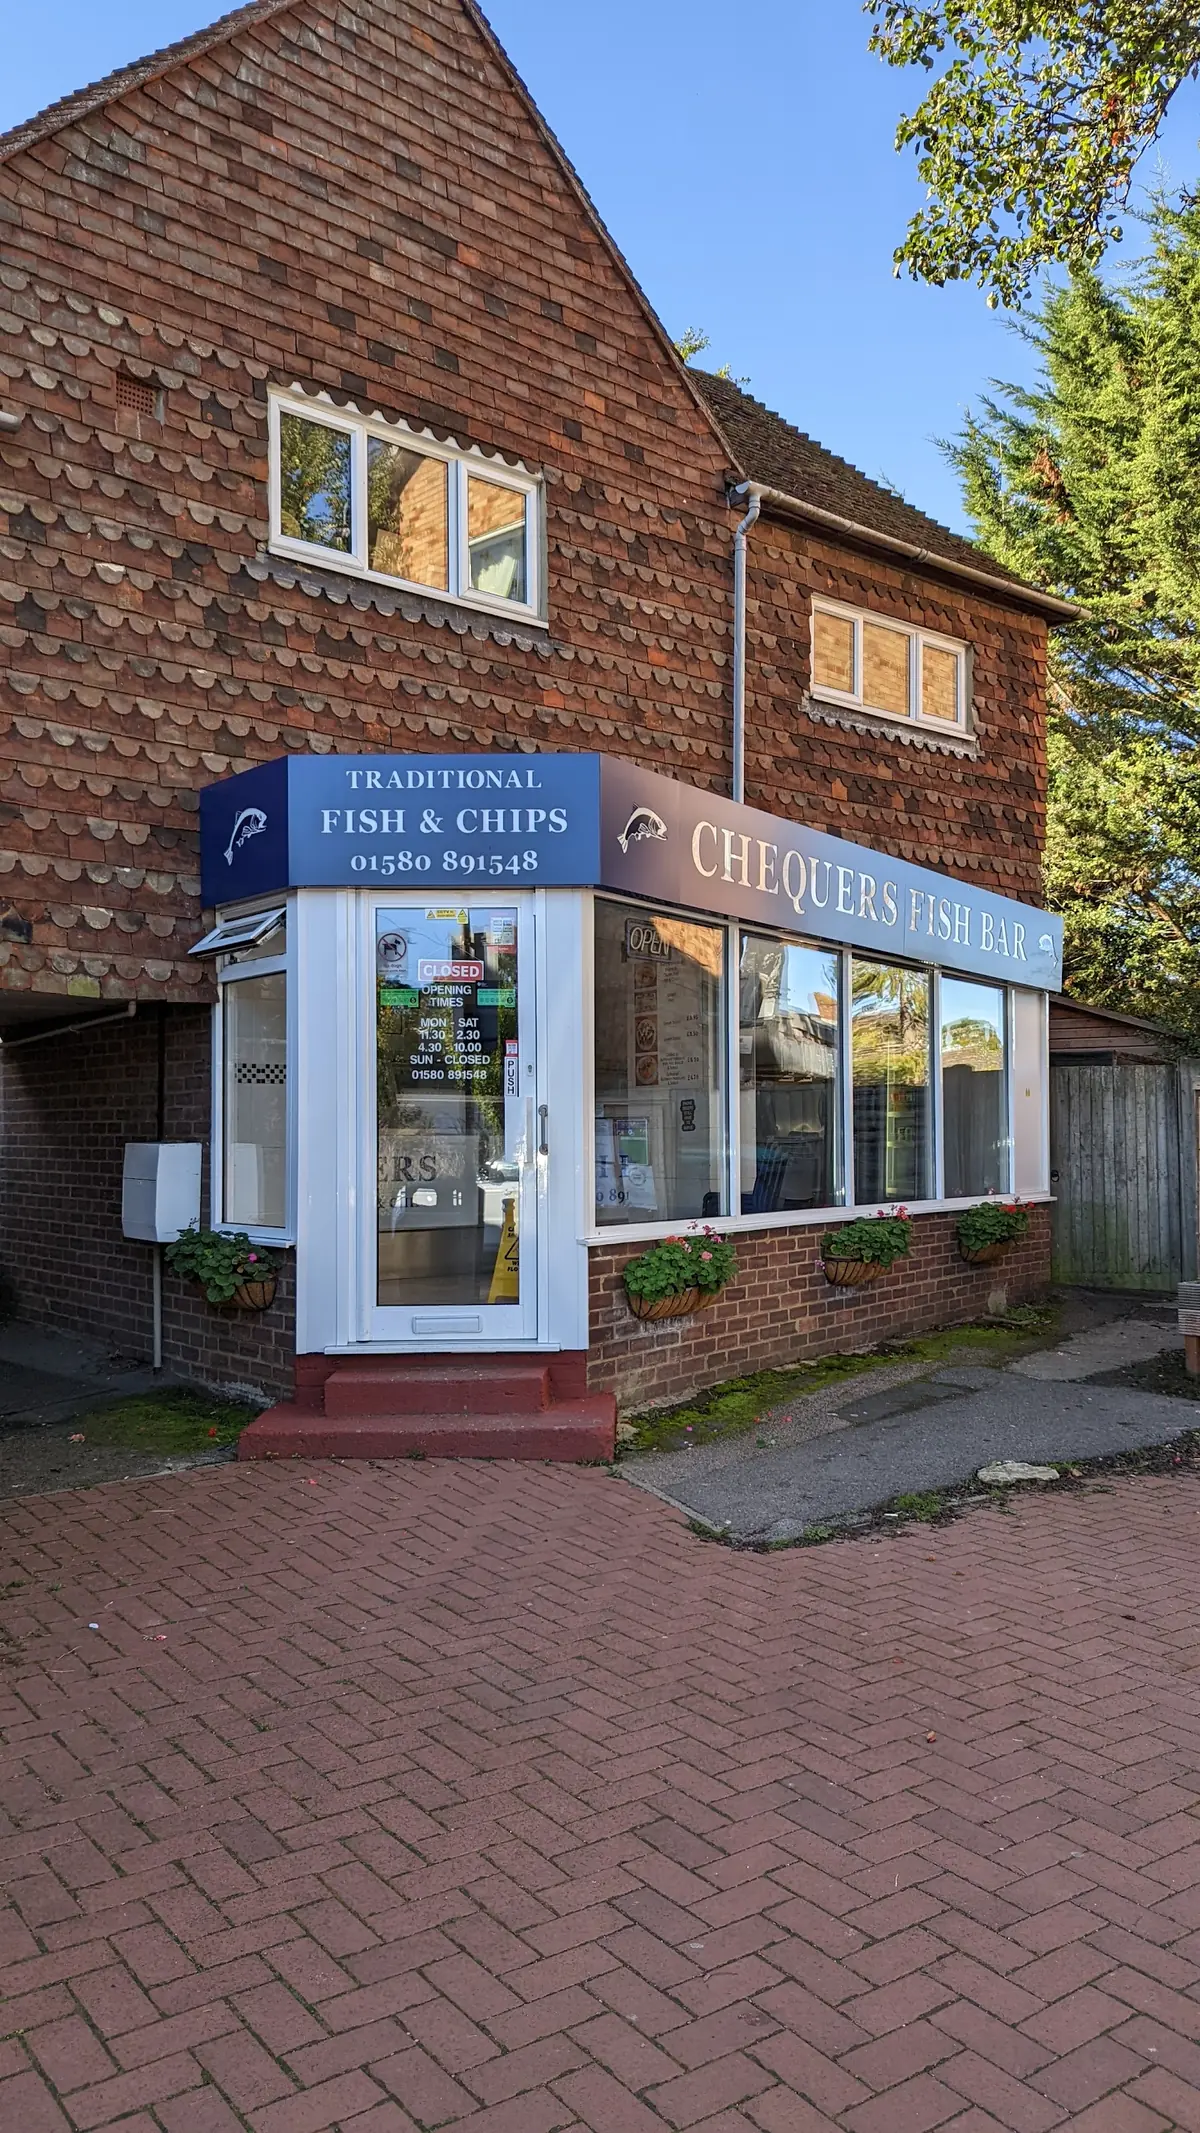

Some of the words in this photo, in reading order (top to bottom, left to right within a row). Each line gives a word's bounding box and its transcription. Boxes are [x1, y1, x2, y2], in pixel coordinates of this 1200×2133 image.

[346, 769, 542, 789] TRADITIONAL
[321, 809, 406, 834] FISH
[420, 809, 445, 834] &
[456, 808, 568, 834] CHIPS
[350, 850, 431, 877] 01580
[442, 850, 539, 877] 891548
[691, 820, 899, 927] CHEQUERS
[908, 888, 972, 947] FISH
[979, 911, 1028, 962] BAR
[630, 926, 670, 956] OPEN
[423, 965, 480, 978] CLOSED
[422, 985, 472, 995] OPENING
[430, 998, 464, 1007] TIMES
[420, 1018, 447, 1027] MON
[458, 1018, 479, 1027] SAT
[421, 1030, 446, 1040] 11.30
[456, 1030, 480, 1040] 2.30
[418, 1043, 442, 1052] 4.30
[454, 1043, 482, 1052] 10.00
[410, 1055, 433, 1065] SUN
[444, 1055, 491, 1065] CLOSED
[412, 1070, 444, 1080] 01580
[447, 1070, 487, 1080] 891548
[507, 1060, 515, 1095] PUSH
